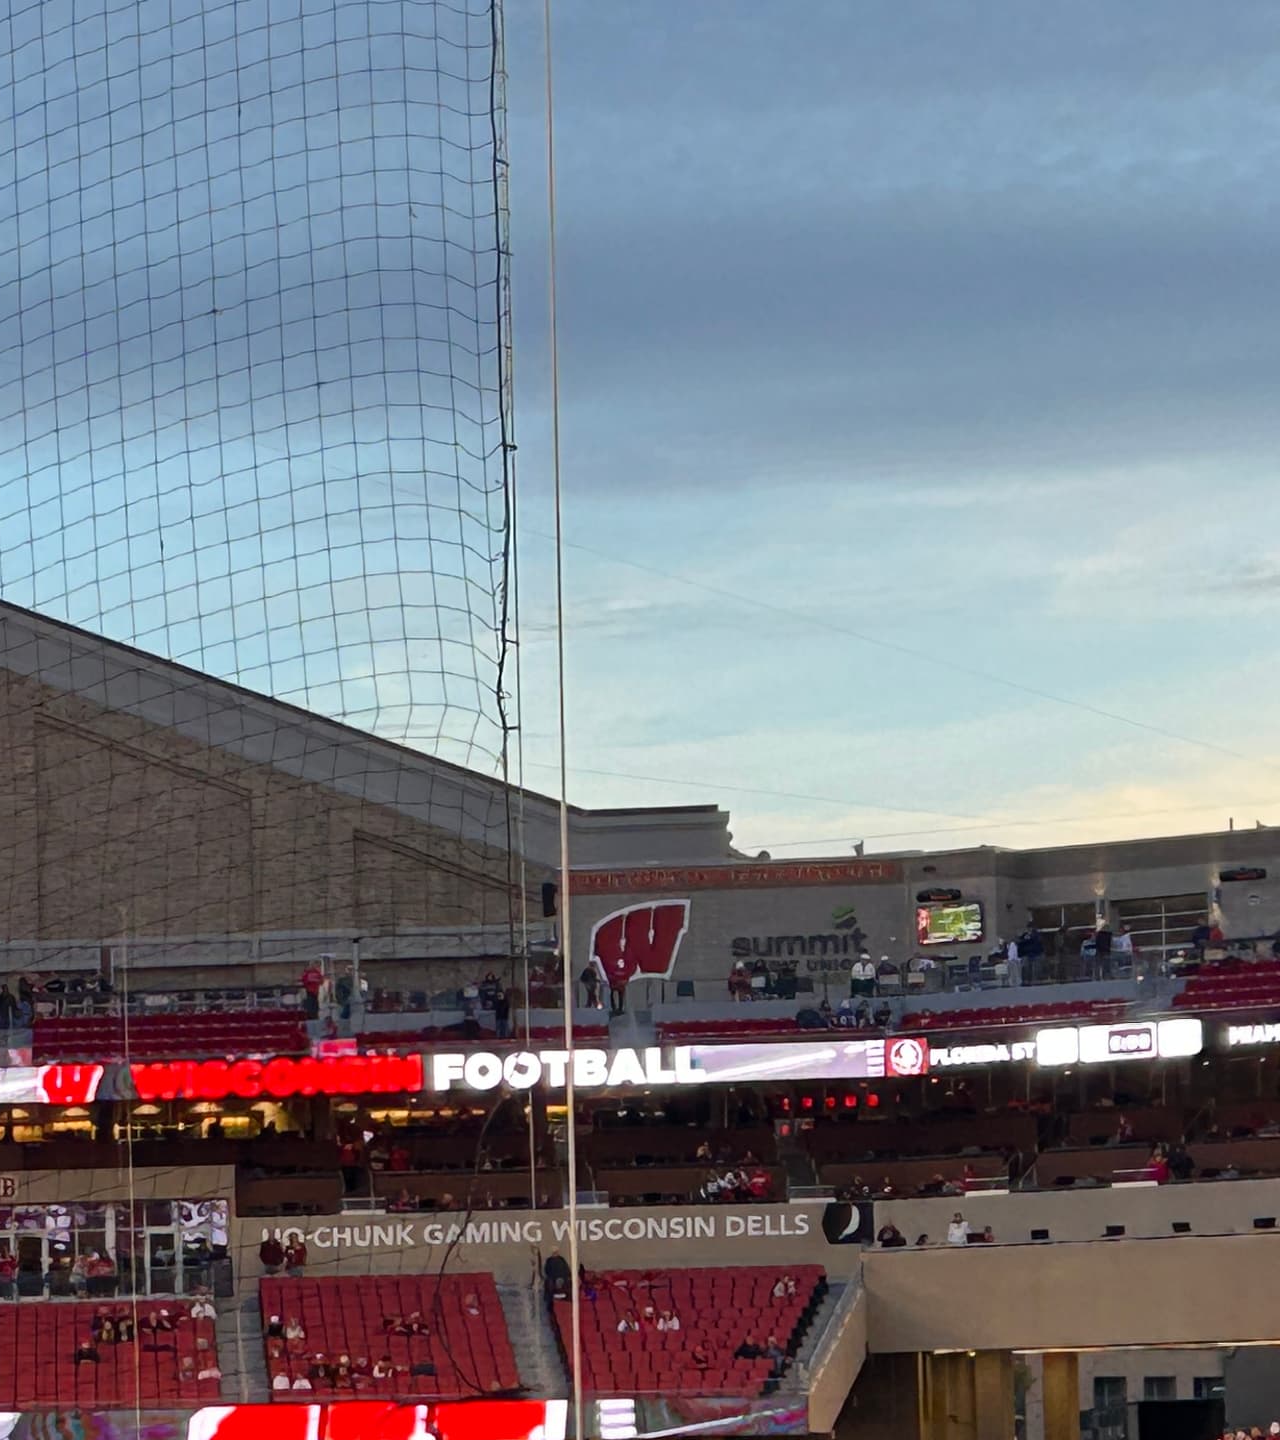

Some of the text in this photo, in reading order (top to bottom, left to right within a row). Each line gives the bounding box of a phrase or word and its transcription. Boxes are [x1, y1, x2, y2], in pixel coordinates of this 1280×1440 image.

[732, 927, 868, 957] summit
[434, 1046, 706, 1091] FOOTBALL
[423, 1221, 542, 1245] GAMING
[552, 1217, 715, 1242] WISCONSIN
[726, 1214, 809, 1237] DELLS
